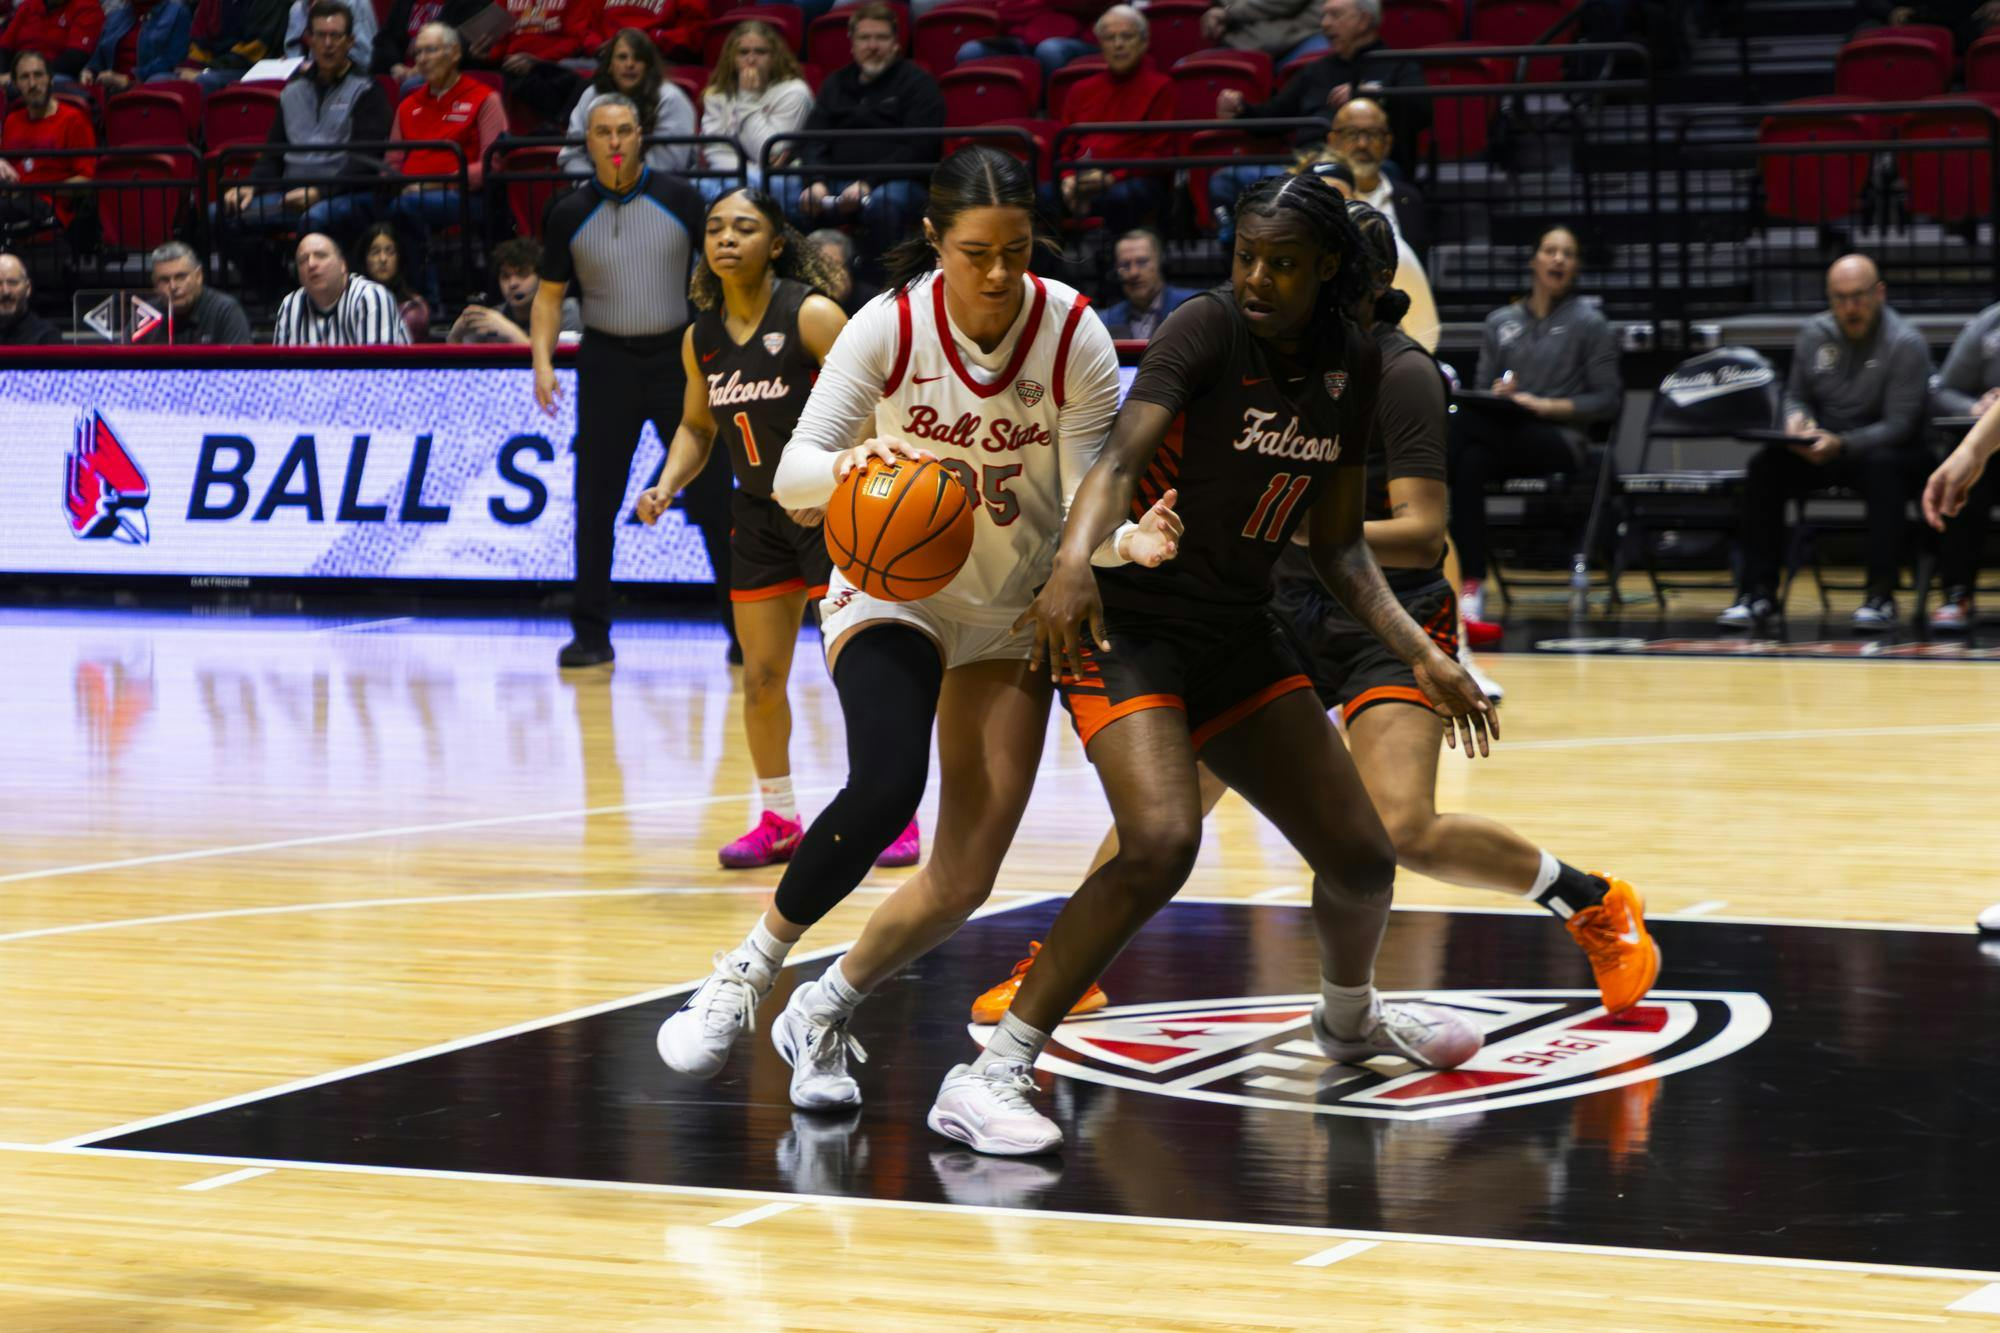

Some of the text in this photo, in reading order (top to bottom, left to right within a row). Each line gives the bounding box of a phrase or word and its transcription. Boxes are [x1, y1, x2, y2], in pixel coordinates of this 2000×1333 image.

[734, 411, 762, 467] 1
[902, 405, 1052, 452] Ball State
[1234, 407, 1342, 462] Falcons
[186, 434, 451, 523] BALL
[1241, 472, 1311, 542] 11
